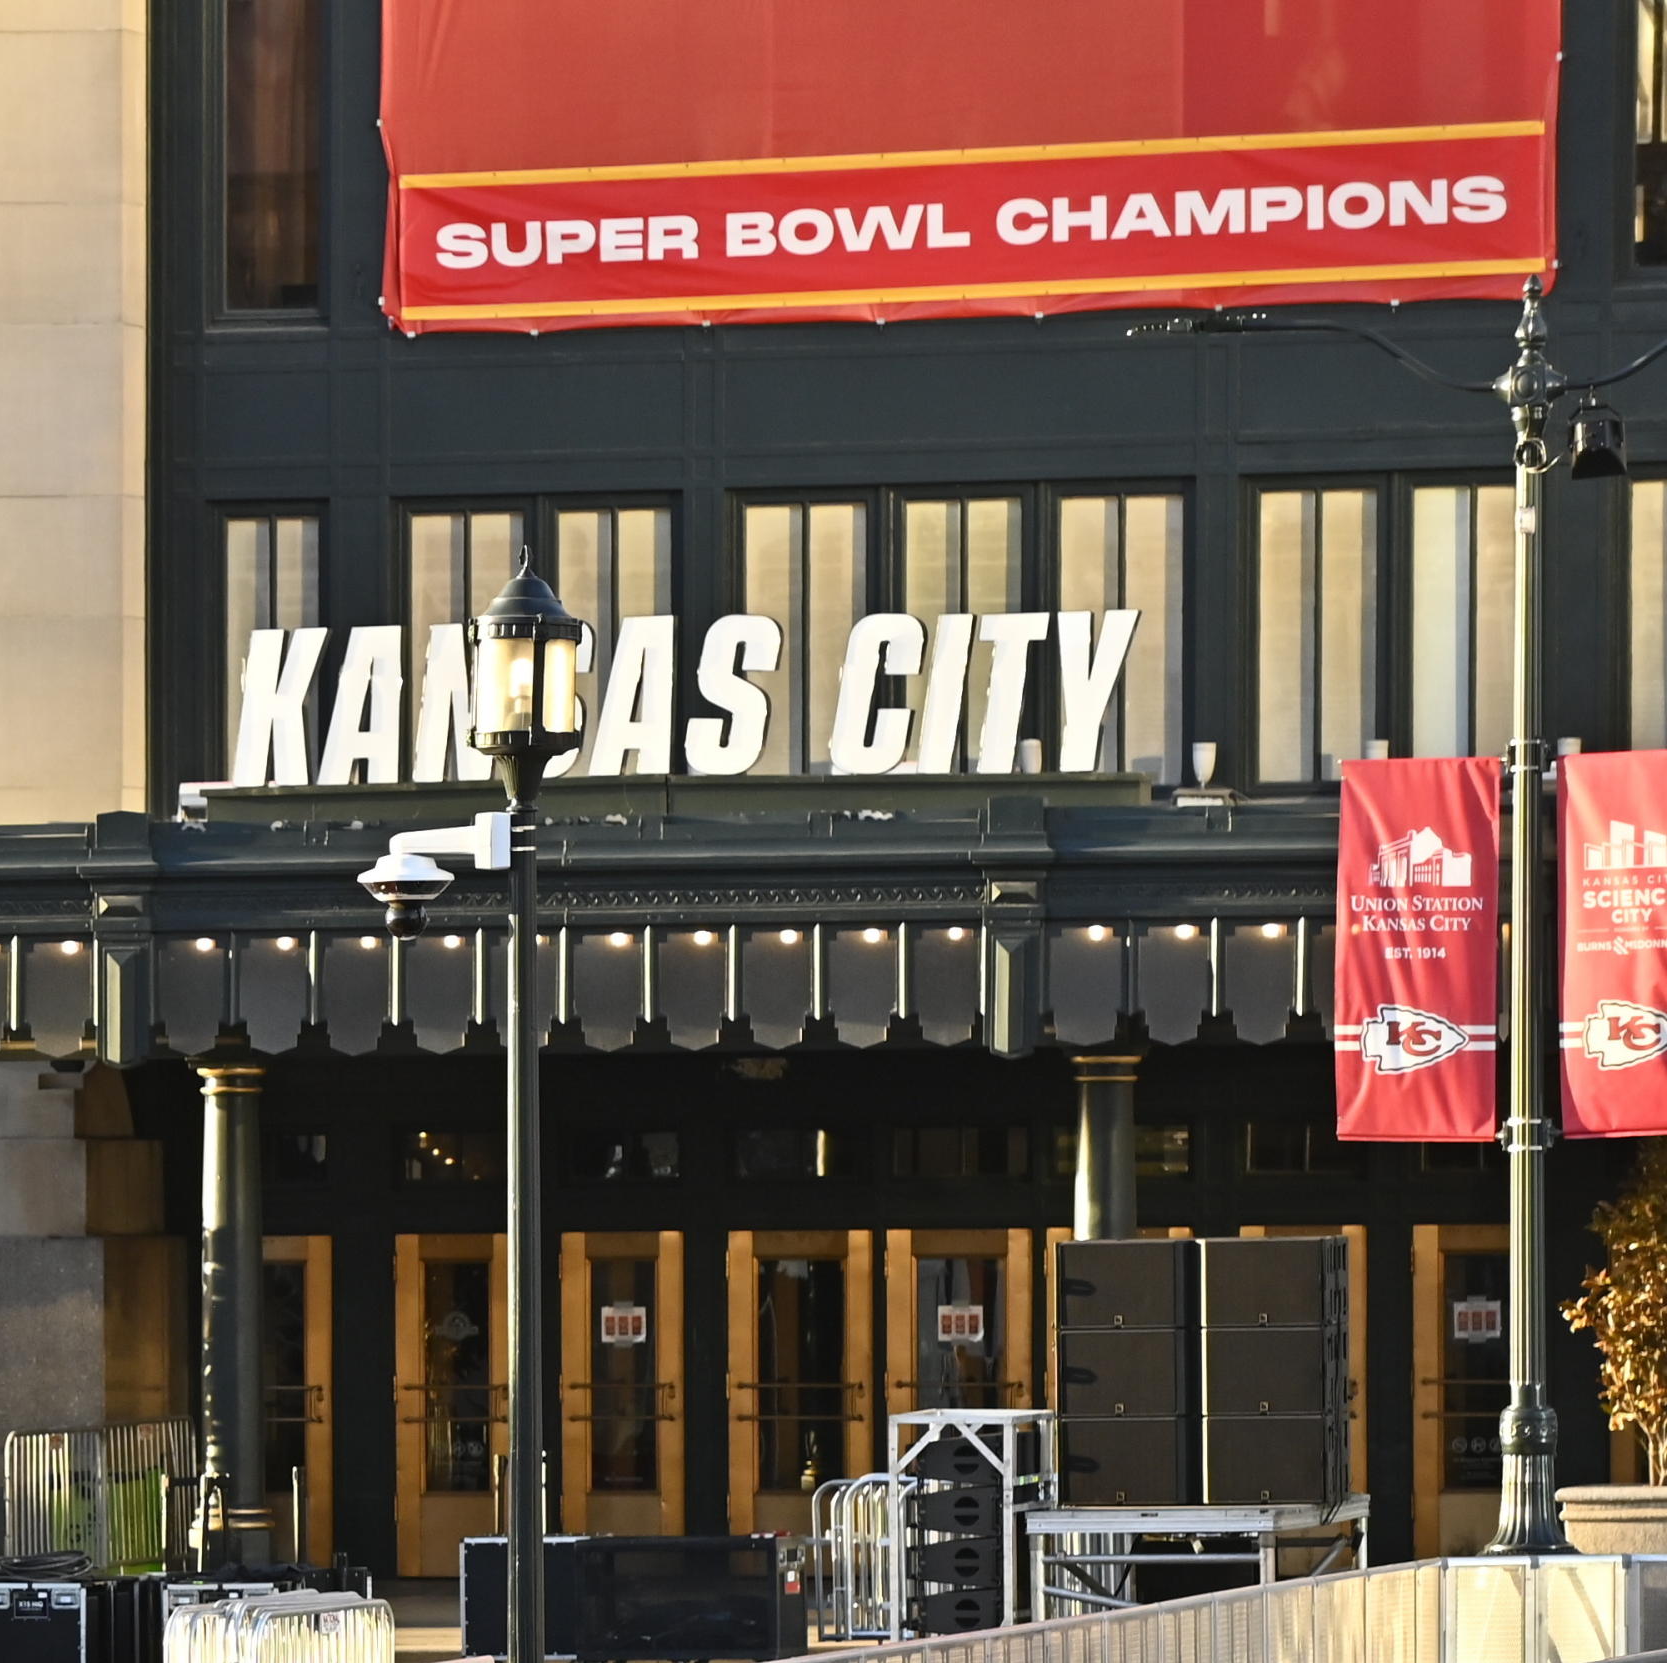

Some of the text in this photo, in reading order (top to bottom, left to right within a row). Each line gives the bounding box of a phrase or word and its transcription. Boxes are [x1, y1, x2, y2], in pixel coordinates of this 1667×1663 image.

[435, 175, 1508, 269] SUPER BOWL CHAMPIONS
[829, 609, 1142, 774] CITY
[1582, 875, 1639, 887] KANSAS
[1350, 895, 1483, 912] UNION STATION
[1362, 914, 1471, 931] KANSAS CITY
[1611, 909, 1653, 924] CITY
[1385, 947, 1446, 959] EST. 1914
[1577, 941, 1612, 952] BURNS
